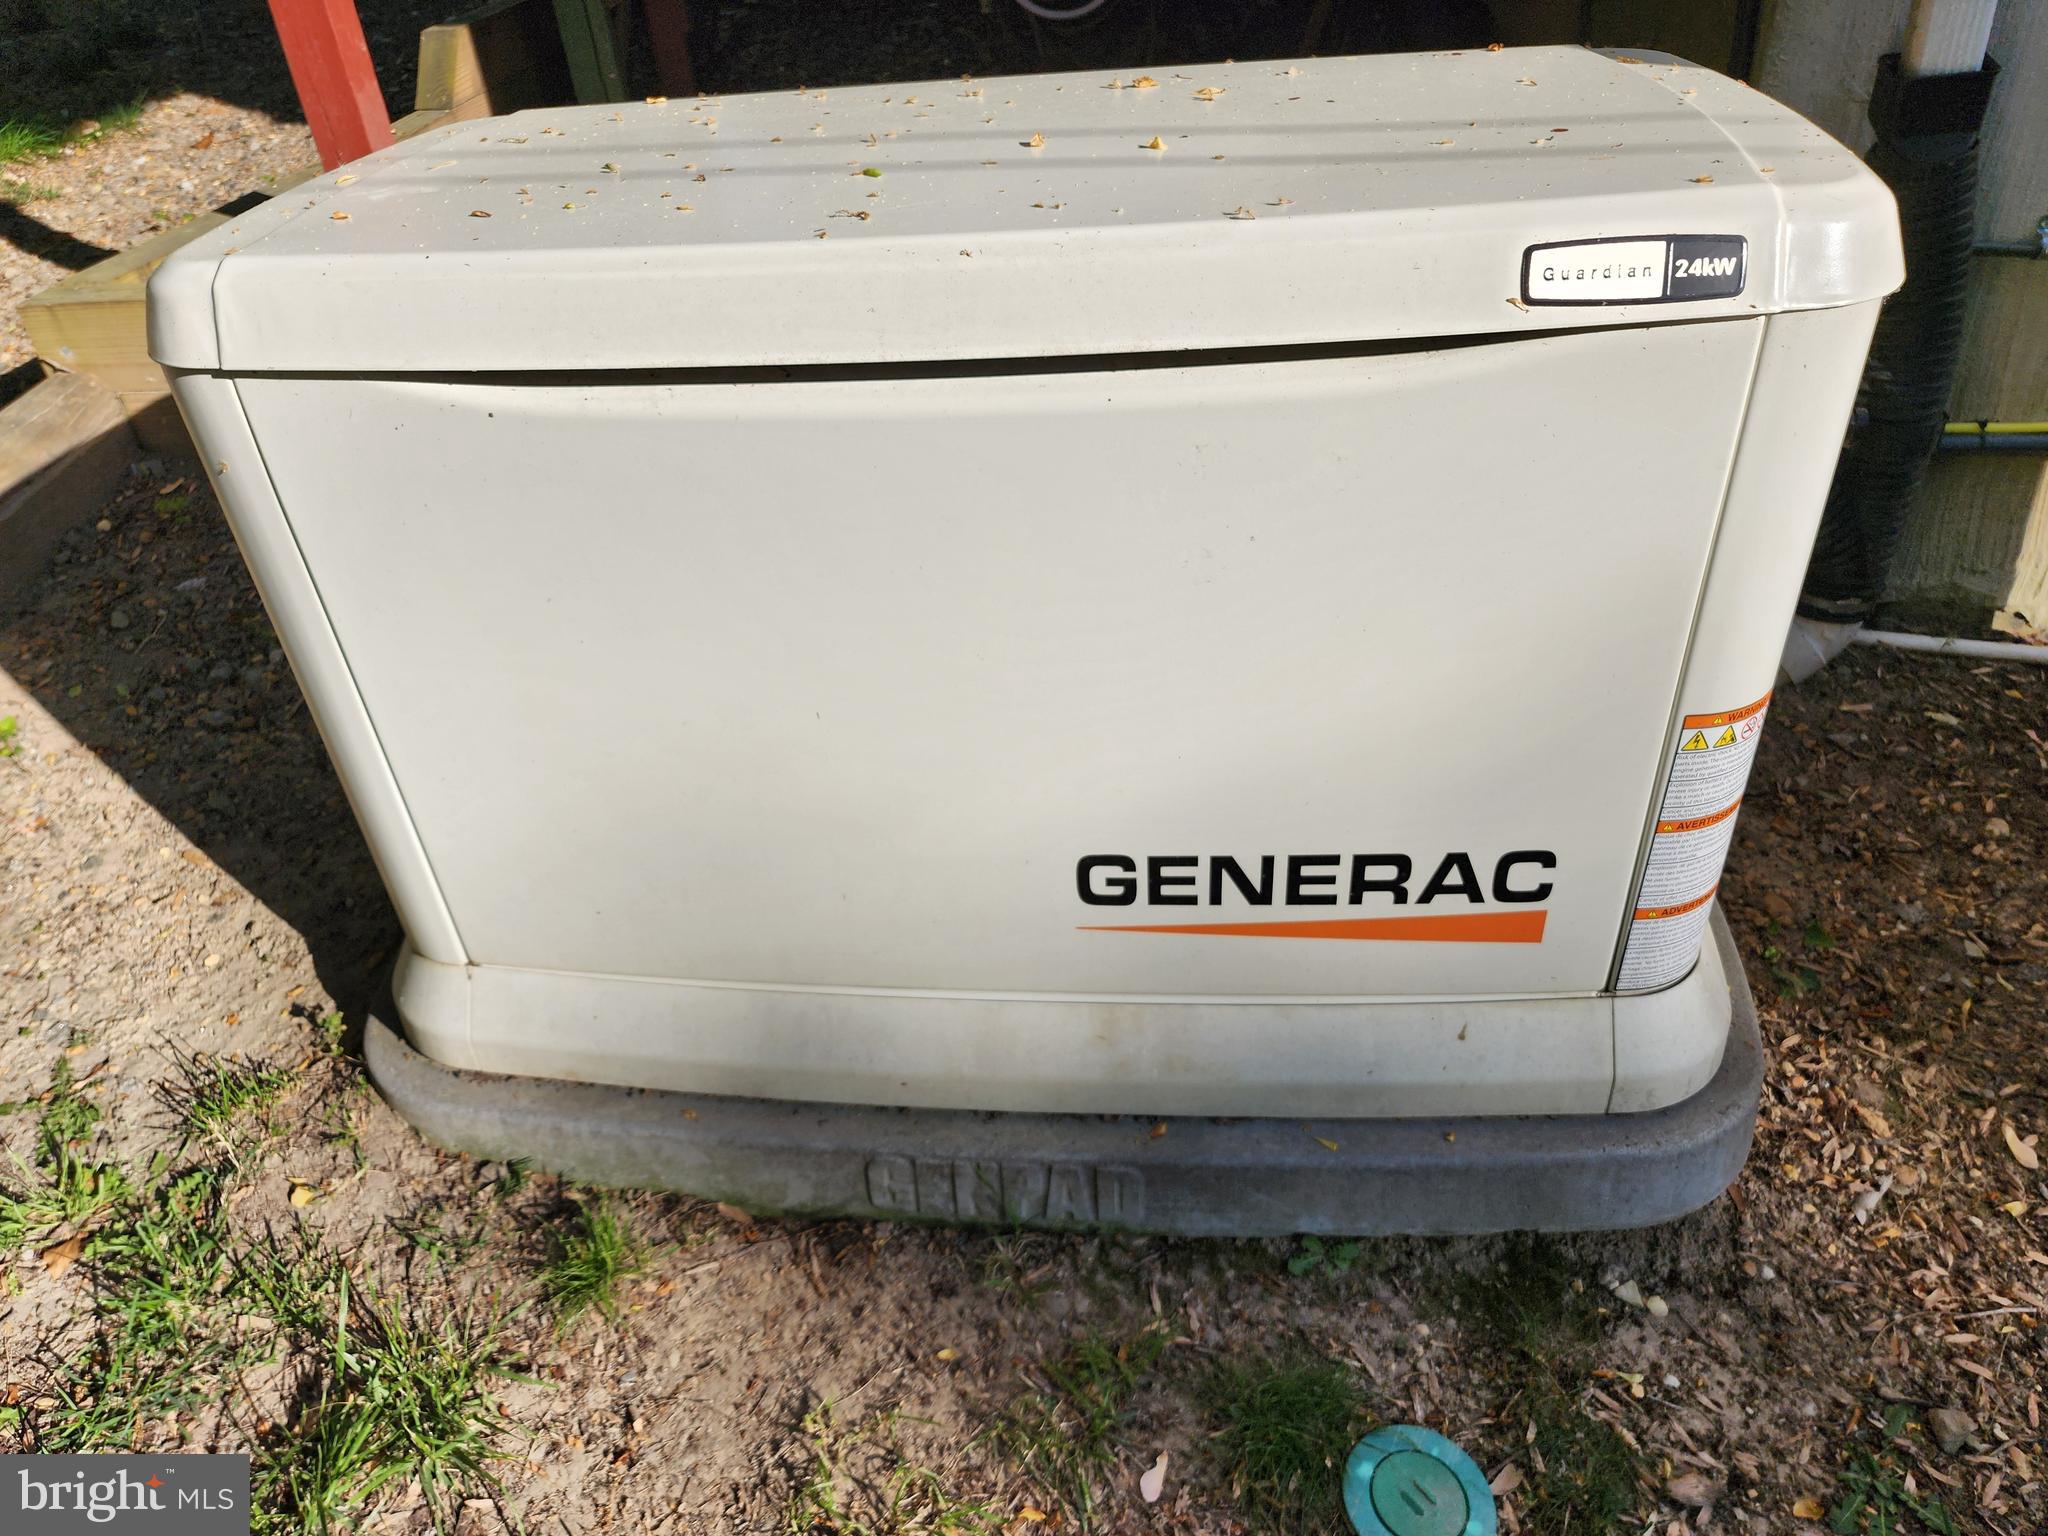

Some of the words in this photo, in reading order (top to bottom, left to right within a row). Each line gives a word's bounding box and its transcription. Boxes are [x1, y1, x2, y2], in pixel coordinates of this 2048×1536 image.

[1543, 264, 1652, 282] Guardian
[1674, 256, 1737, 278] 24kW
[1076, 850, 1557, 906] GENERAC
